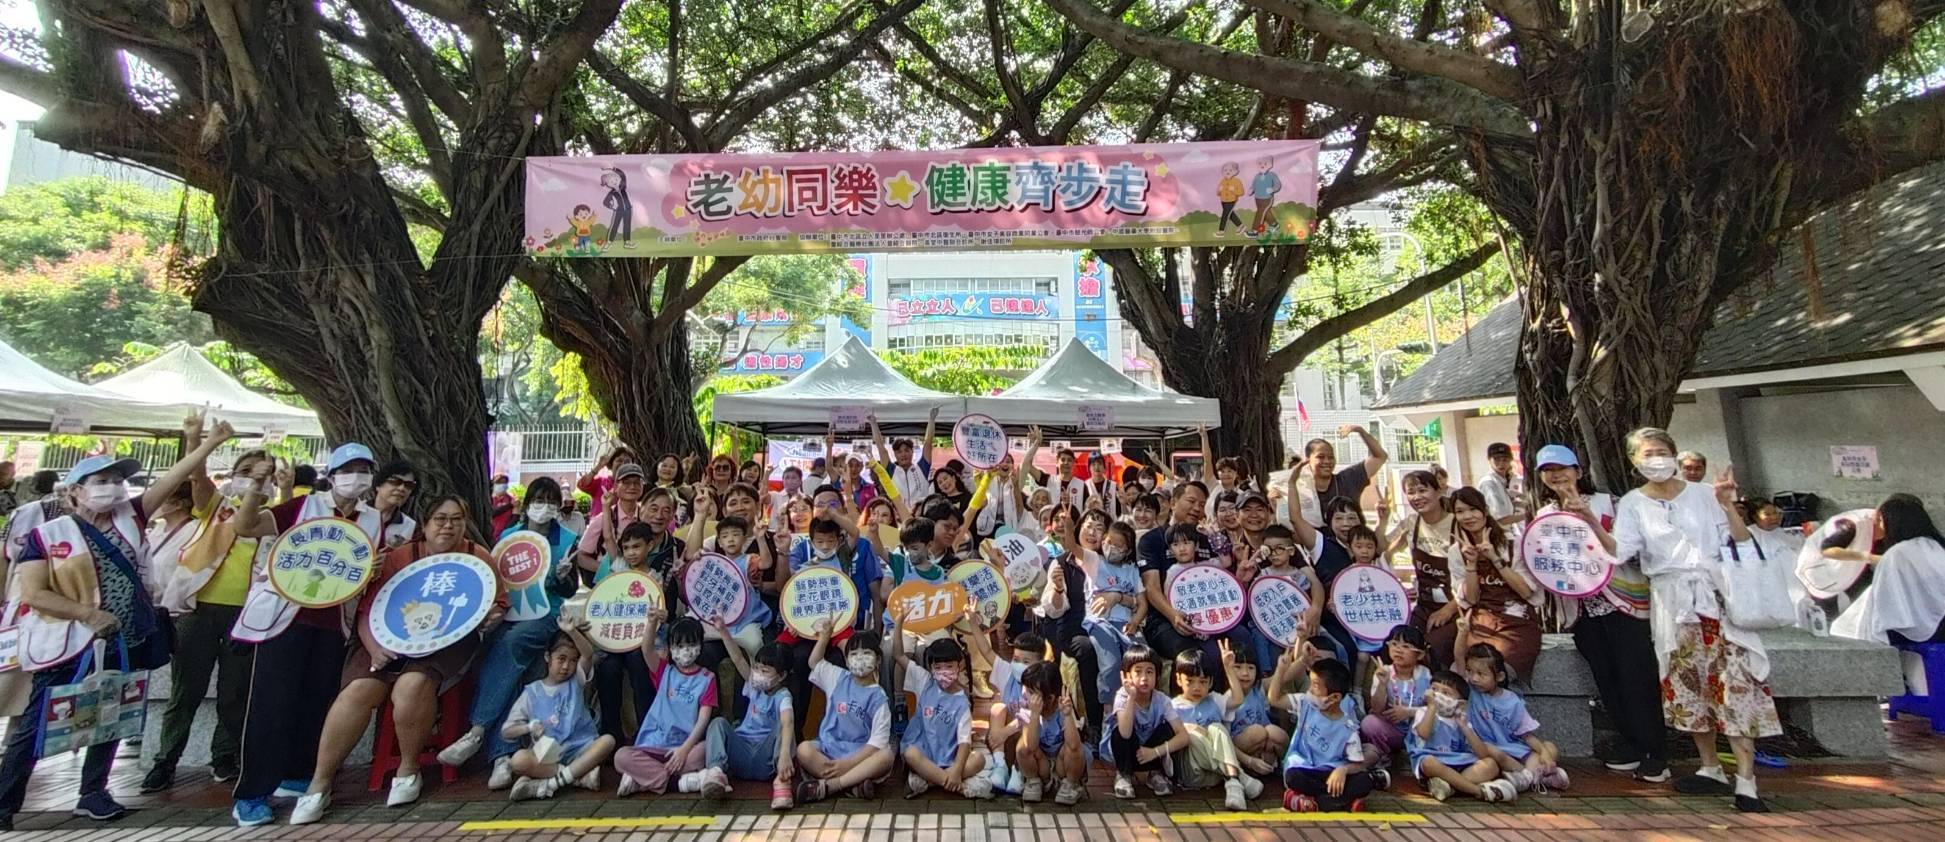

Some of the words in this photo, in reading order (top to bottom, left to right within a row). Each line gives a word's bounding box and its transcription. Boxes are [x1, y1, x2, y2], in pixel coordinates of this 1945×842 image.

[689, 167, 880, 217] 老幼同樂
[925, 162, 1147, 212] 健康齊步走
[290, 525, 370, 561] 長青動一動
[1002, 538, 1025, 563] 油
[277, 550, 364, 582] 活力百分百
[507, 550, 530, 566] THE
[1535, 557, 1601, 576] 服務中心
[420, 570, 458, 598] 棒
[1177, 578, 1228, 596] 敬老愛心卡
[902, 590, 954, 622] 活力
[1342, 593, 1398, 607] 老少共好
